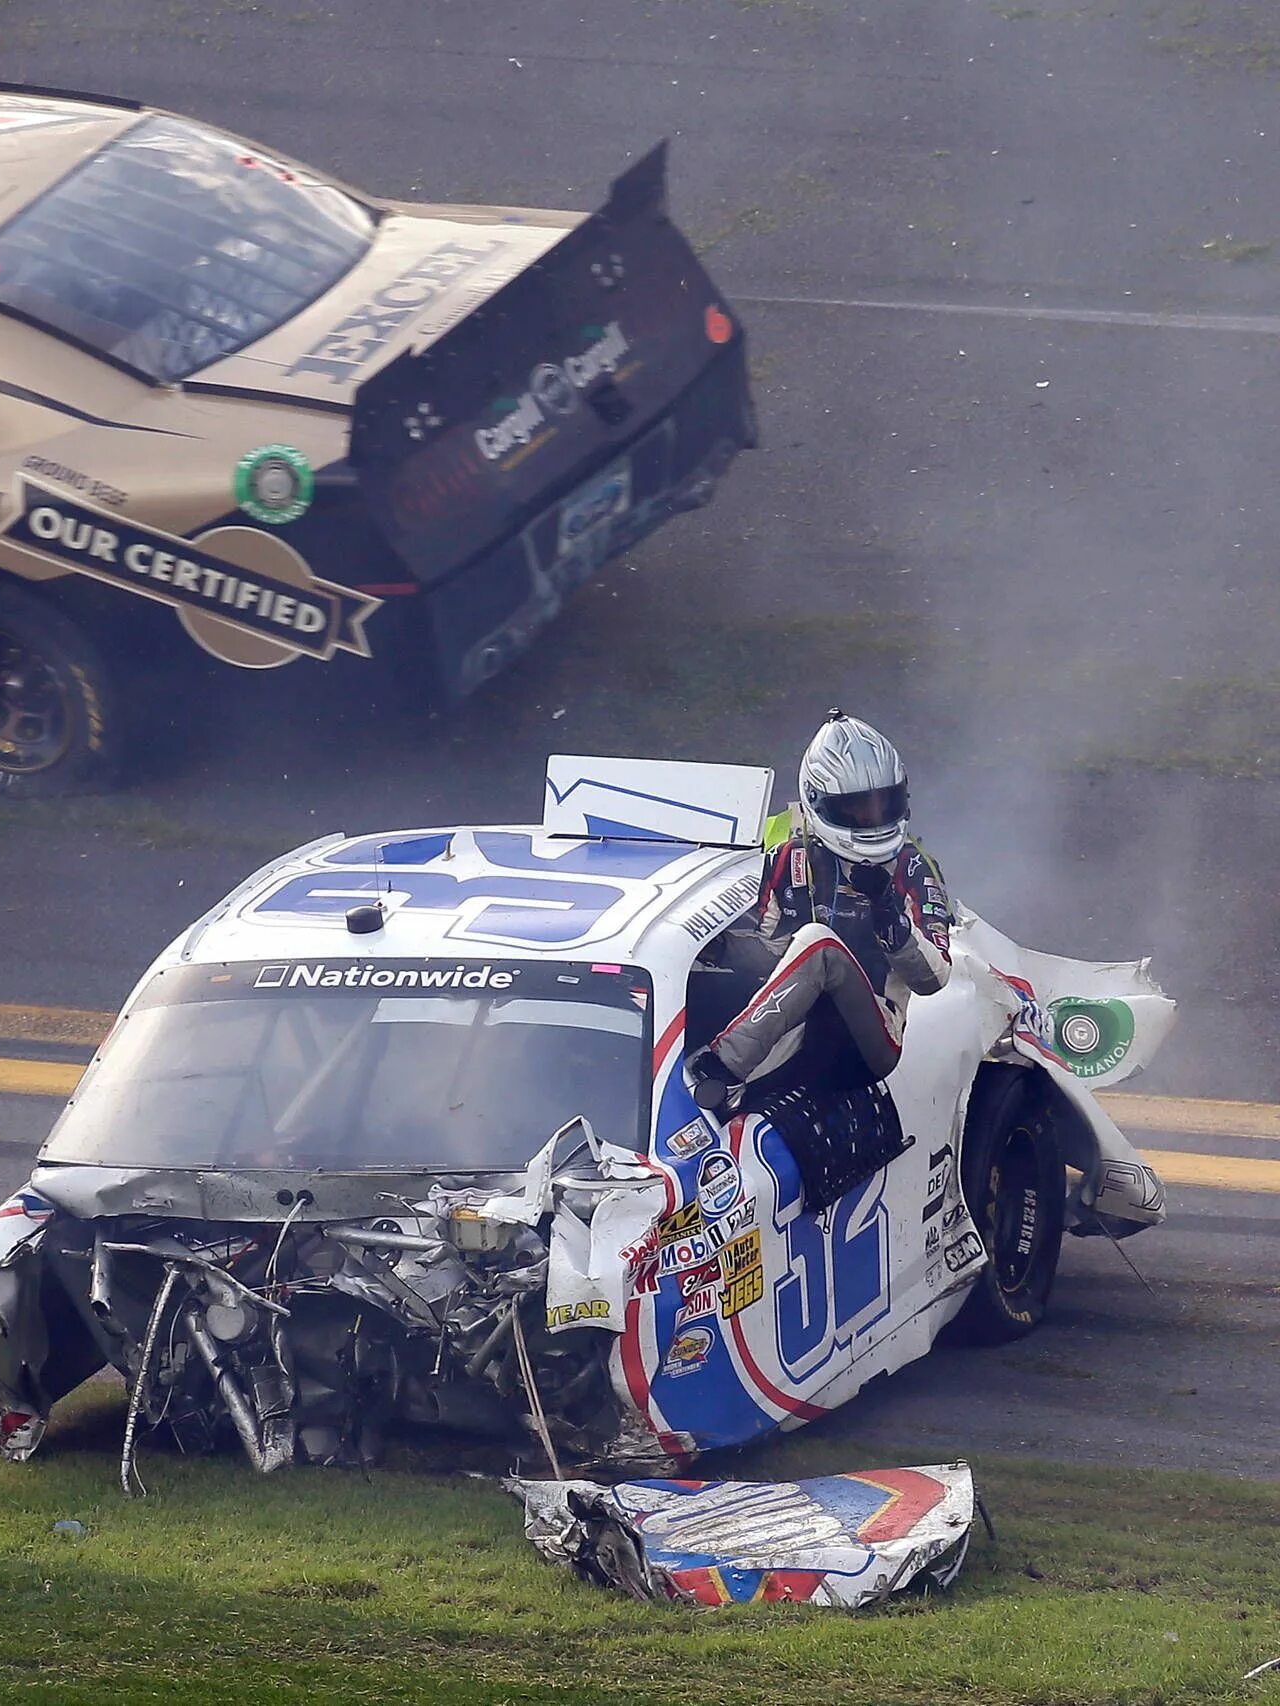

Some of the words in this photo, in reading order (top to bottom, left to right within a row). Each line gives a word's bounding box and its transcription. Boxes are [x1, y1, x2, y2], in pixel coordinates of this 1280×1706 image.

[281, 239, 511, 384] EXCEL
[28, 507, 117, 563] OUR
[123, 544, 327, 634] CERTIFIED
[681, 900, 725, 942] KYLE
[287, 964, 516, 990] Nationwide
[734, 1237, 754, 1258] Auto
[734, 1248, 759, 1271] Meter
[753, 1116, 891, 1385] 32
[946, 1234, 982, 1268] SEM
[723, 1266, 763, 1319] JEGS
